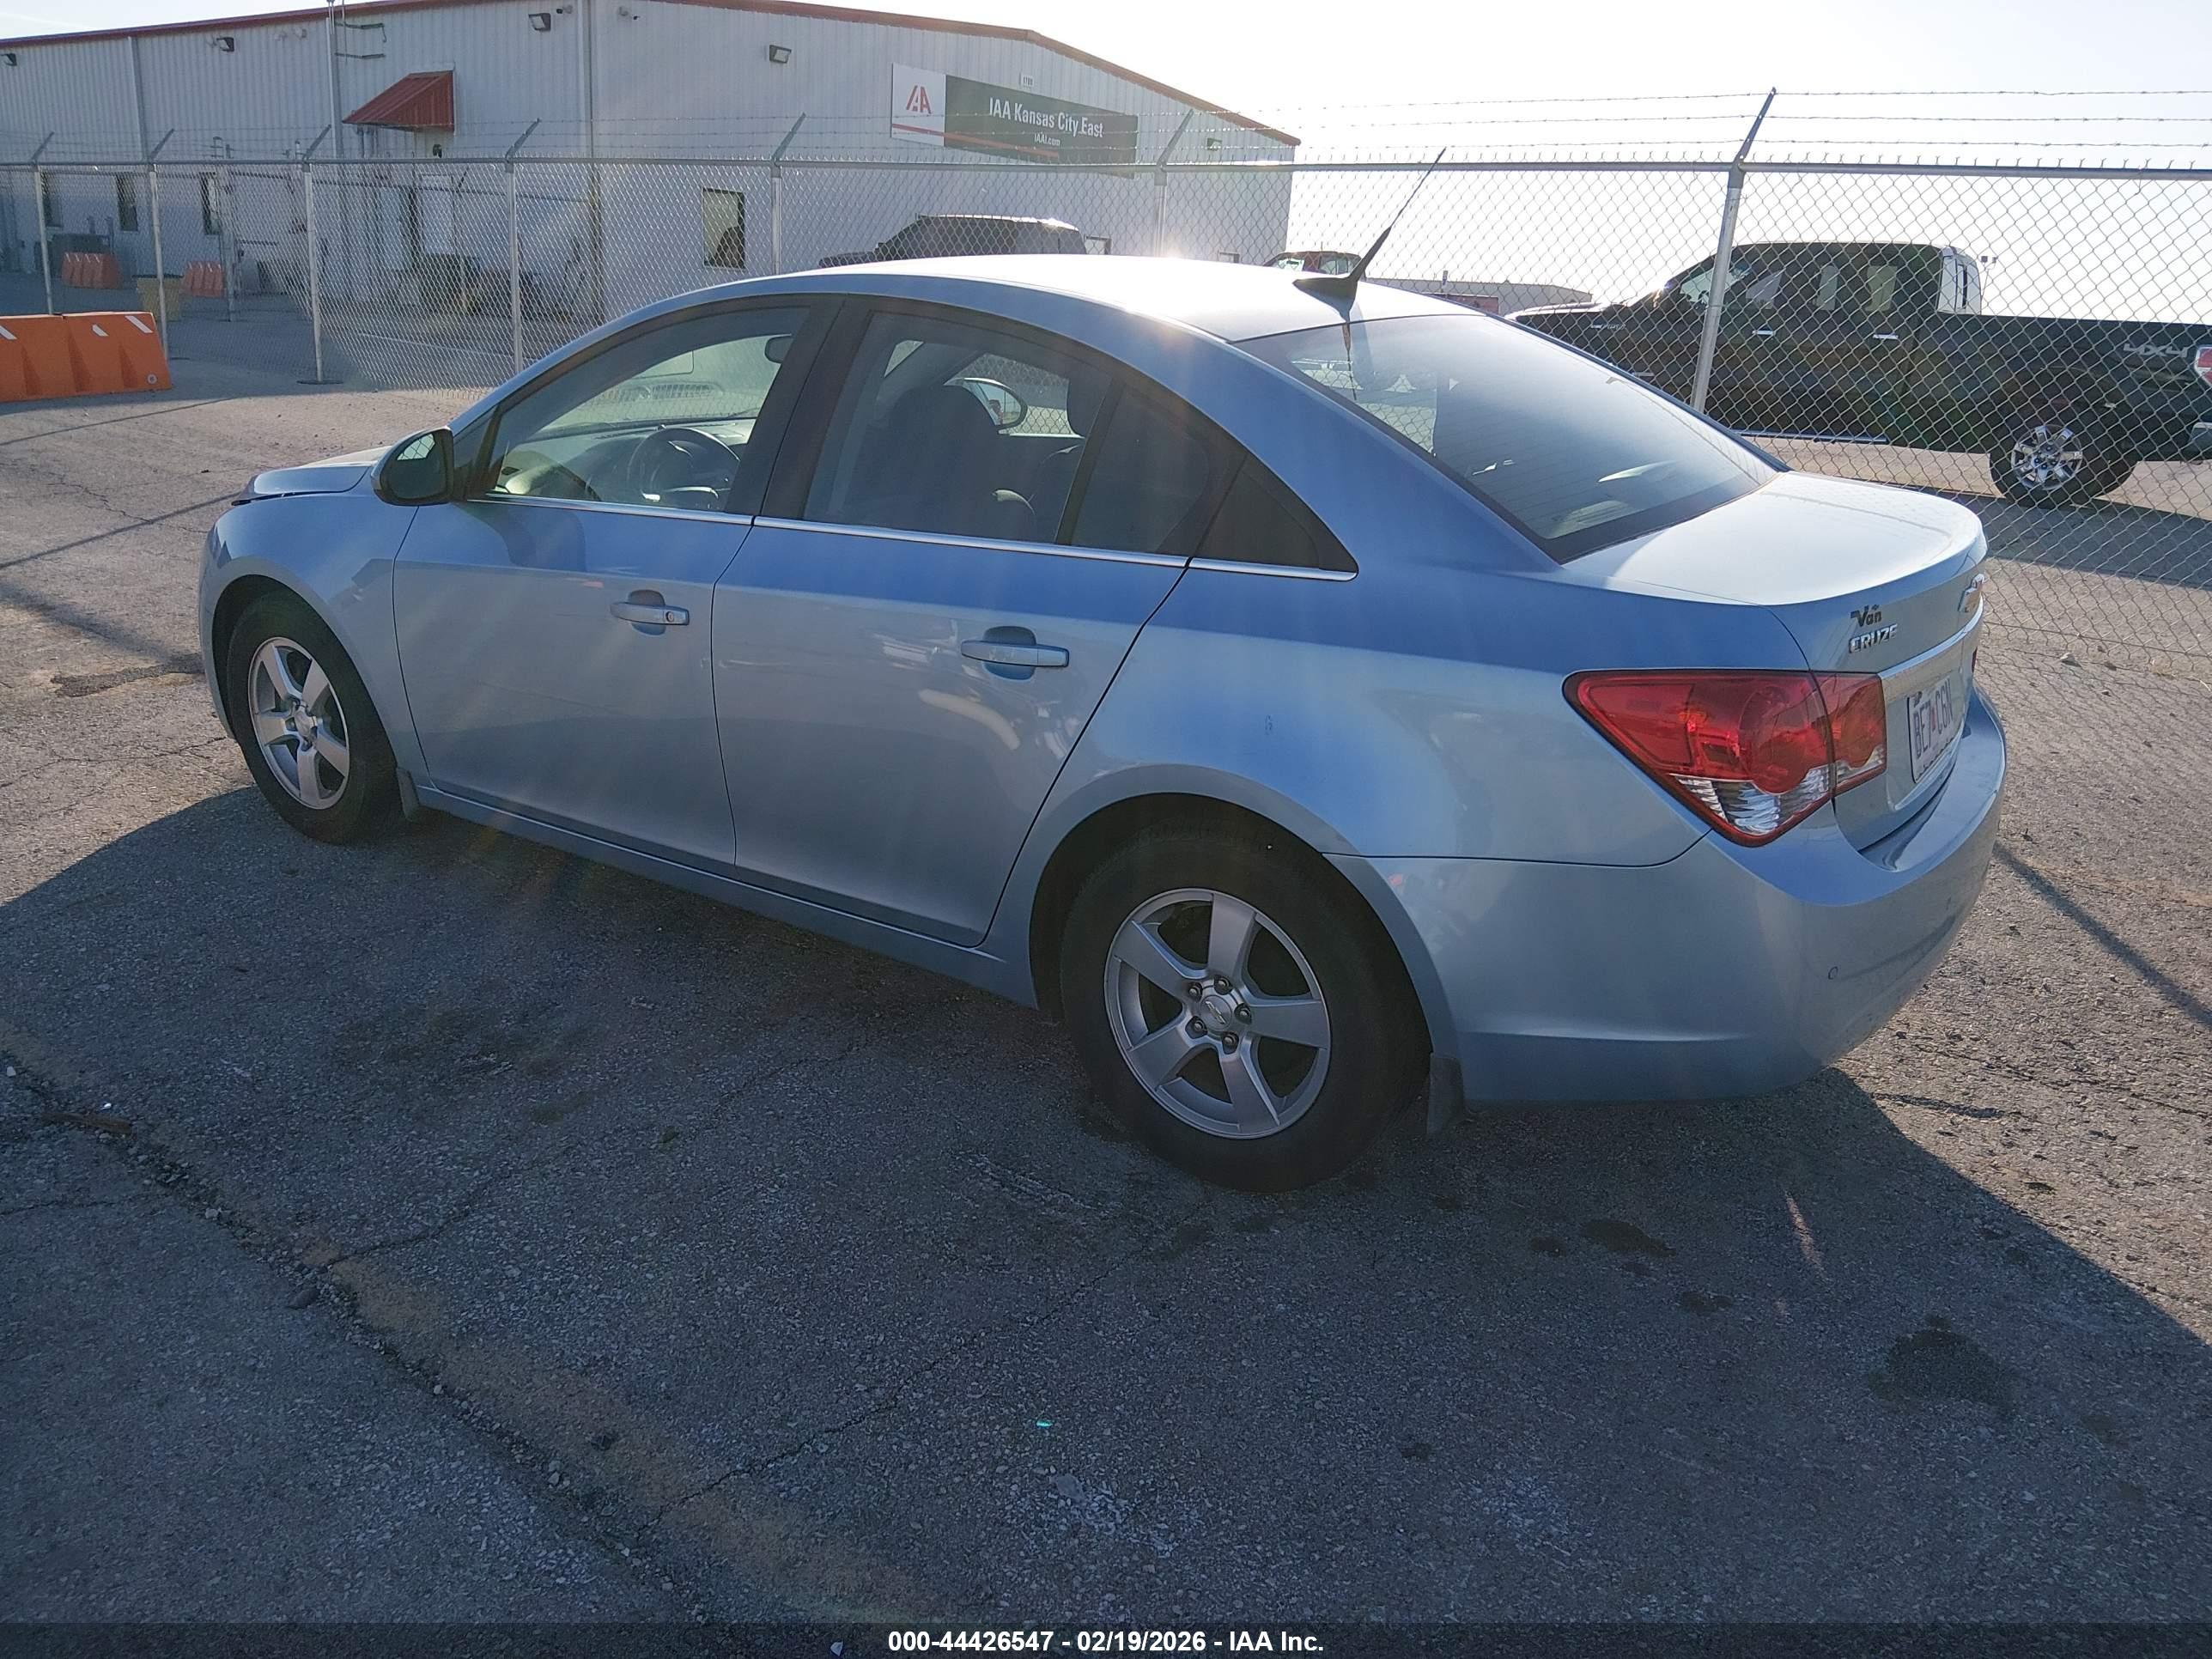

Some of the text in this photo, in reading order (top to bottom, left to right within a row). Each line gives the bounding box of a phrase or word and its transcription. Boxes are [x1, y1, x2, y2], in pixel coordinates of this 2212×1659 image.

[989, 96, 1103, 138] IAA Kansas City East
[1849, 623, 1898, 653] CRUZE
